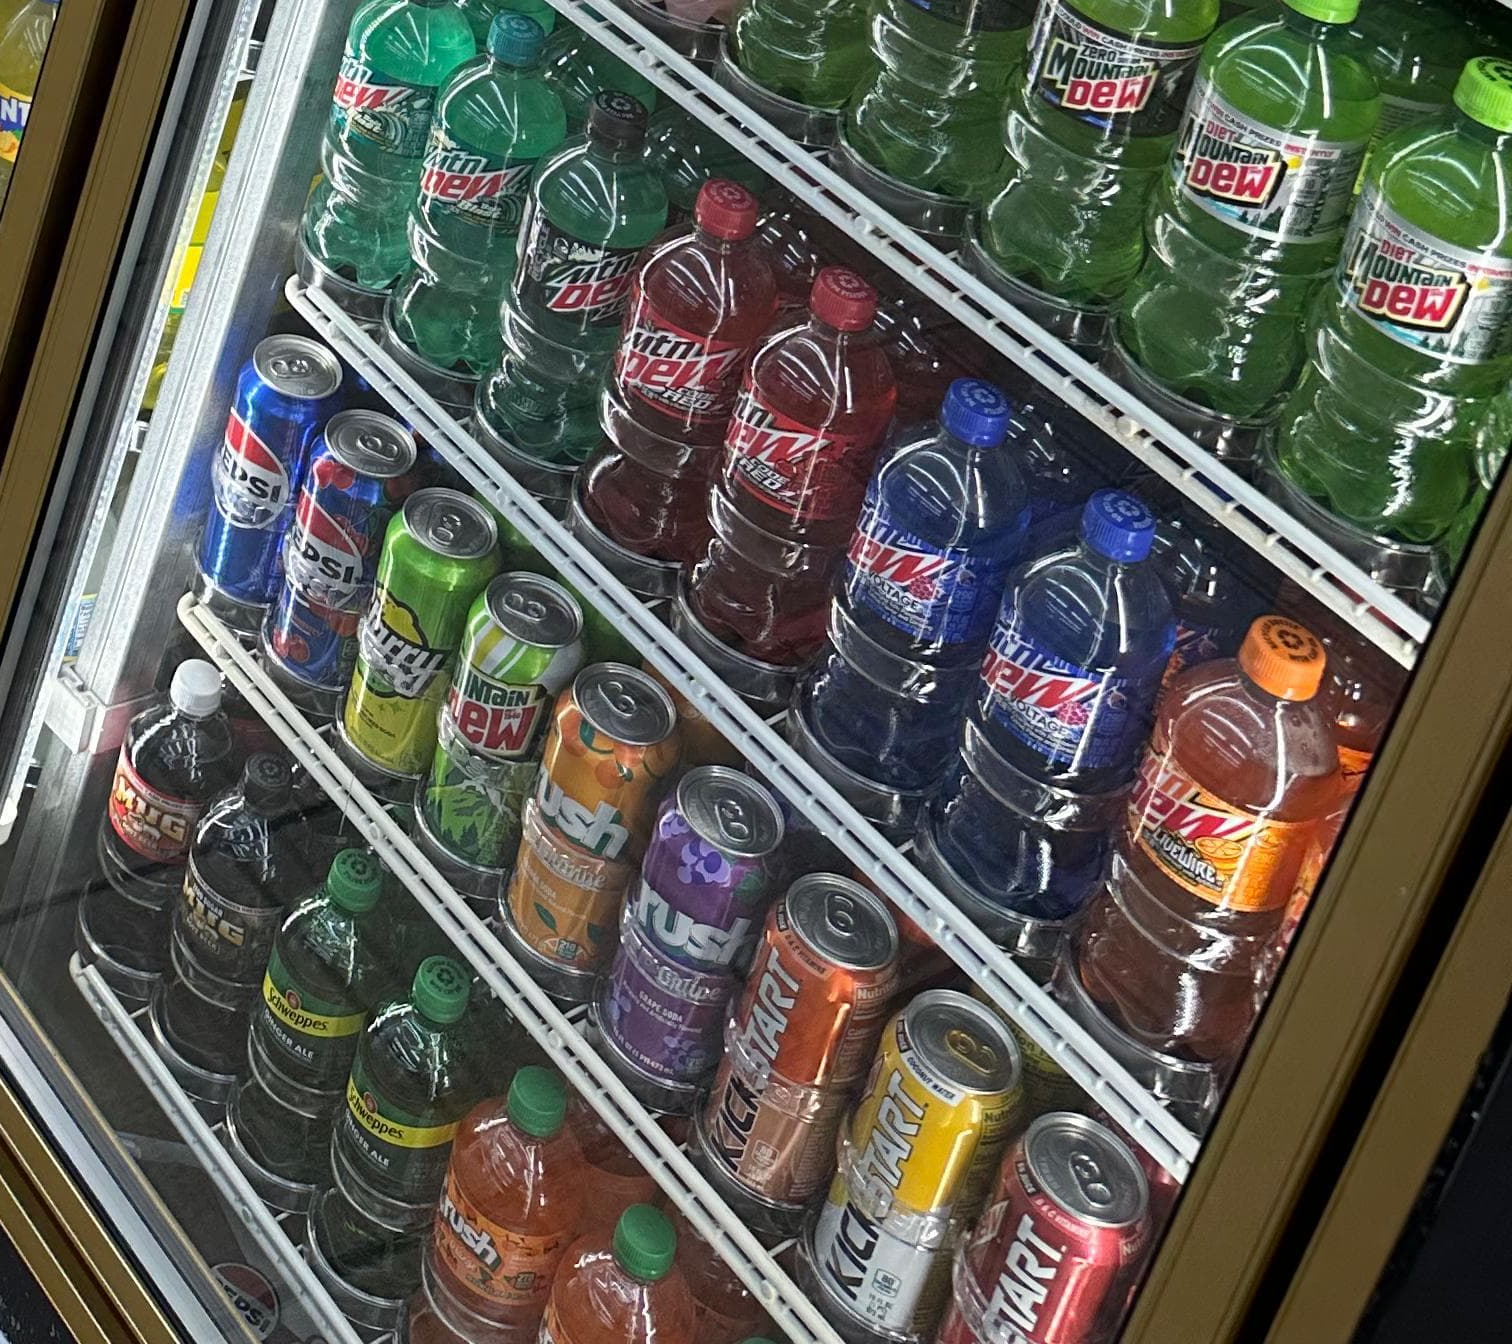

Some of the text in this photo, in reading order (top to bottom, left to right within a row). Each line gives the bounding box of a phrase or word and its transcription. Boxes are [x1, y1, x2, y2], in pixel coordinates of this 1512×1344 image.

[1046, 39, 1150, 87] MOUNTAIN
[1079, 42, 1118, 63] ZERO
[336, 78, 409, 109] ew
[1065, 74, 1152, 111] DEW
[1206, 119, 1236, 142] DIET
[1284, 143, 1336, 159] INSTNTLY
[1190, 158, 1272, 199] DEW
[1352, 233, 1453, 287] MOUNTAIN
[1380, 239, 1416, 262] DIET
[1402, 233, 1429, 252] CASH
[1363, 278, 1458, 322] DEW
[222, 444, 283, 504] EPSI
[292, 525, 355, 584] EPSI
[868, 572, 921, 610] VOLTAGE
[1009, 693, 1069, 737] VOLTAGE
[116, 775, 186, 842] MUG
[539, 765, 630, 860] ush
[1153, 828, 1217, 883] LIVEWIRE
[640, 879, 752, 965] rush
[267, 986, 329, 1032] Schweppes
[294, 1045, 315, 1060] ALE
[906, 1055, 957, 1103] COCONUT WATER
[349, 1086, 405, 1141] Schweppes
[370, 1148, 390, 1166] ALE
[442, 1195, 500, 1265] rush
